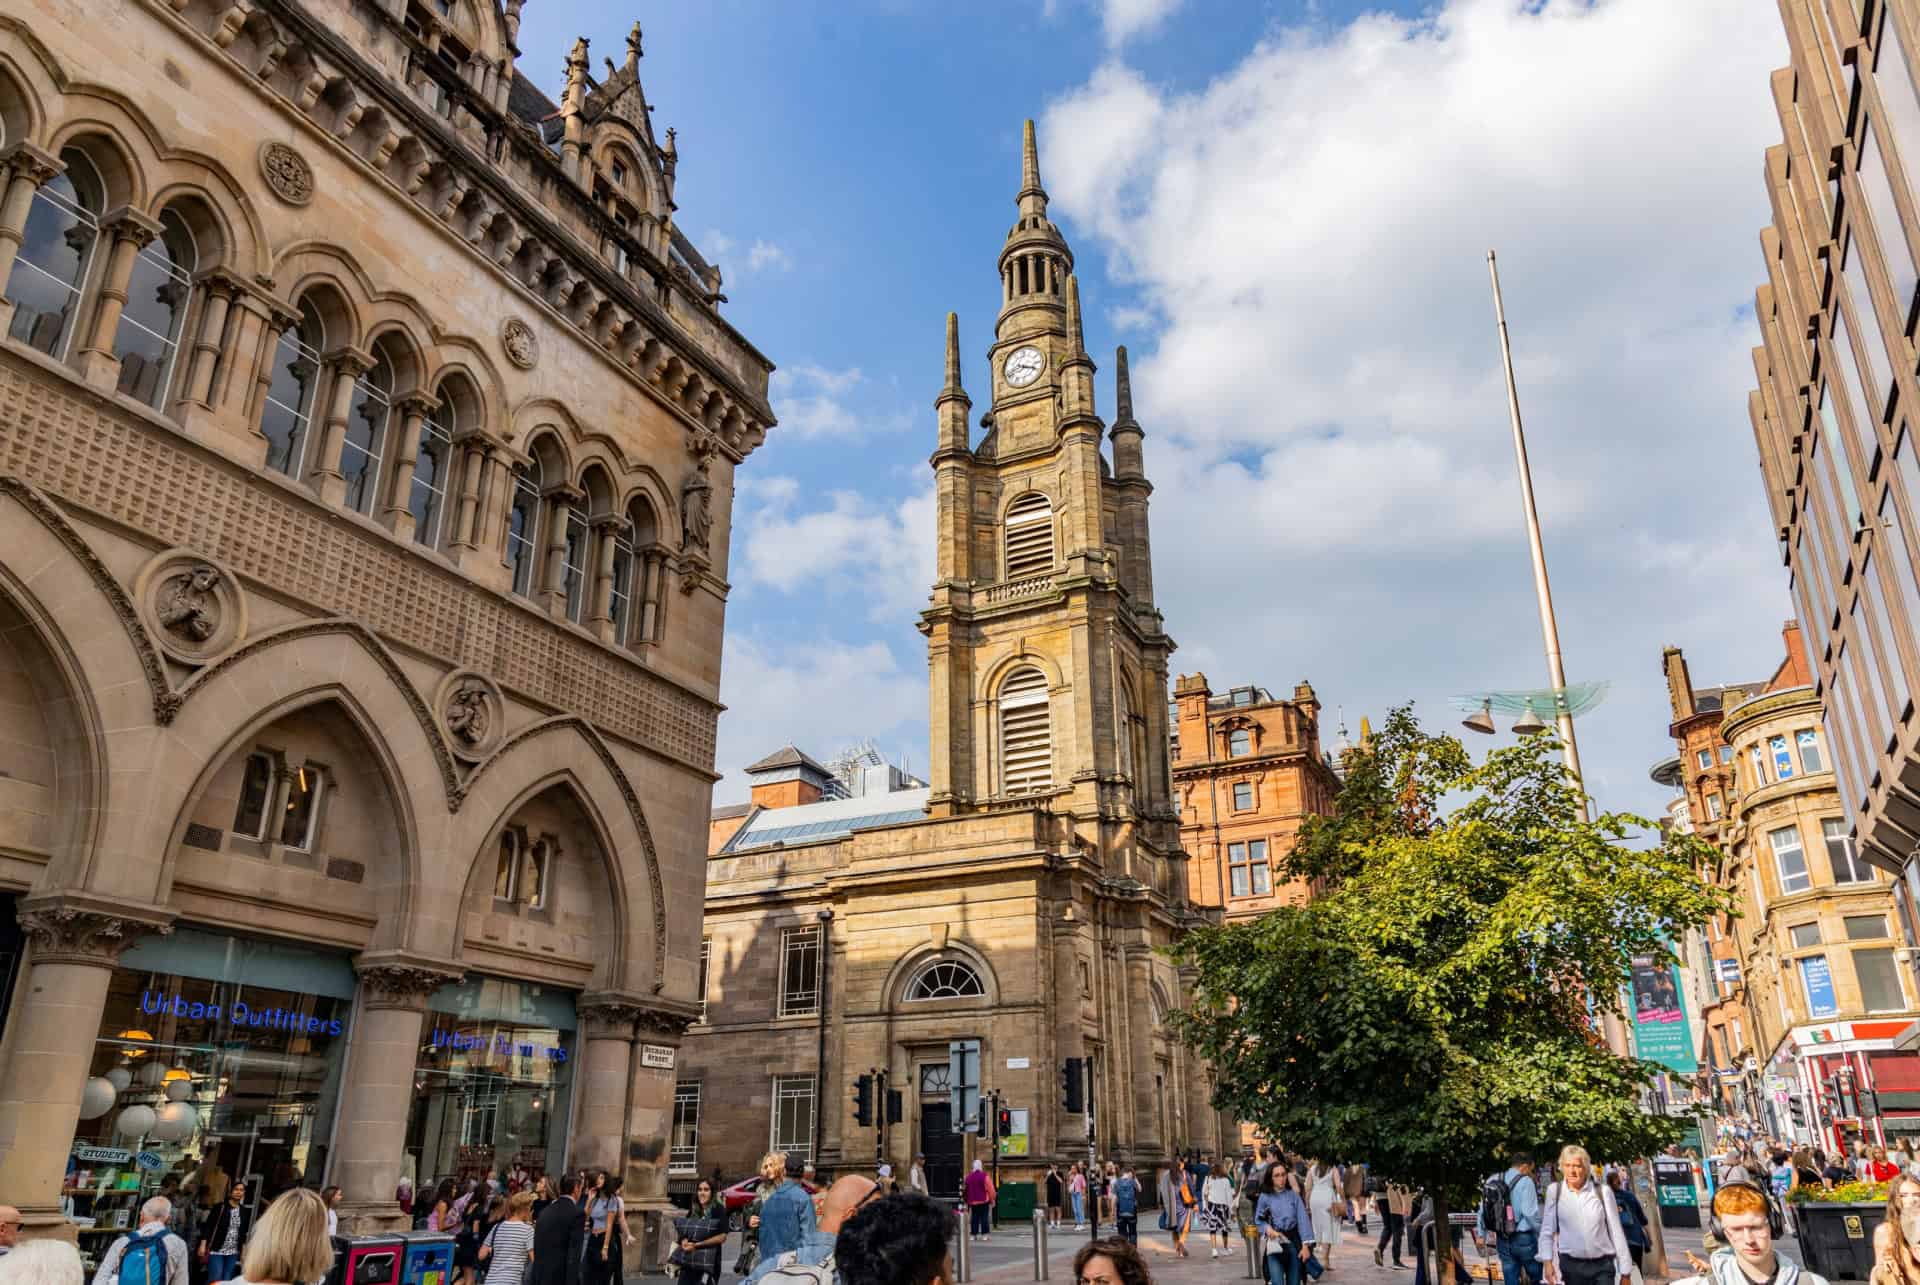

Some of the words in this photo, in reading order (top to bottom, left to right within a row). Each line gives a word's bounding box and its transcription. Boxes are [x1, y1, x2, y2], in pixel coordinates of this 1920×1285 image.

[143, 991, 221, 1019] Urban
[231, 1002, 343, 1036] Outfitters
[432, 1027, 487, 1051] Urban
[83, 1149, 128, 1160] STUDENT
